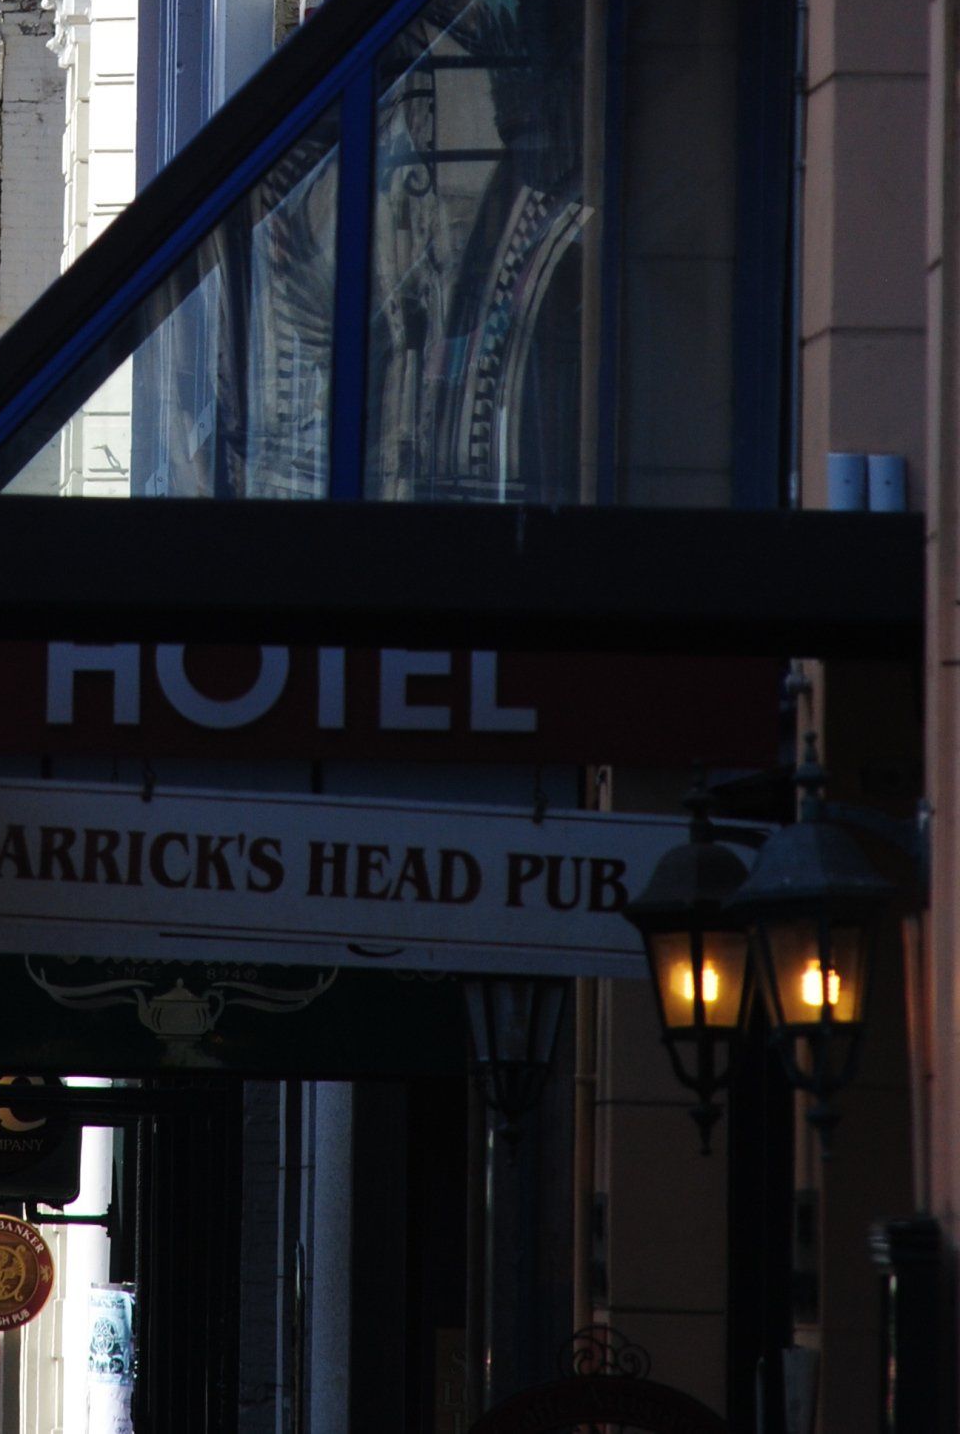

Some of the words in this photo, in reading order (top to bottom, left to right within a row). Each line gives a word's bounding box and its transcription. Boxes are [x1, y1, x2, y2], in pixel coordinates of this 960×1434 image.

[306, 840, 482, 906] HEAD
[505, 852, 630, 915] PUB
[12, 1308, 30, 1325] PUB
